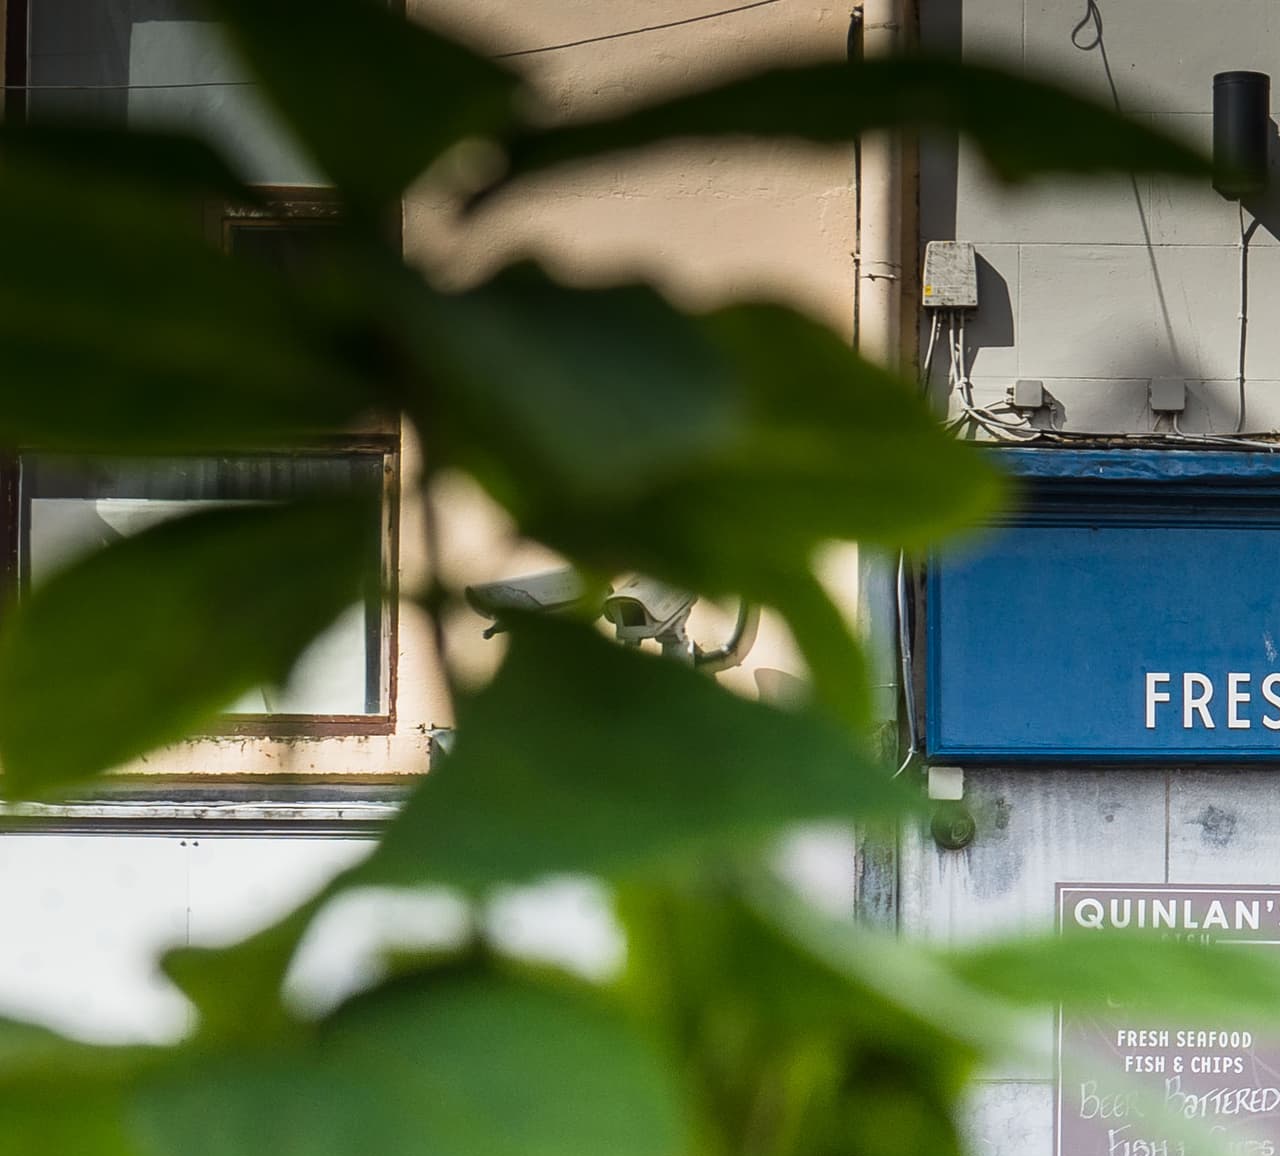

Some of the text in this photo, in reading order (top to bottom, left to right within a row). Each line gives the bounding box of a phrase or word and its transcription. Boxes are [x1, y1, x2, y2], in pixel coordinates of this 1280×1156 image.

[1117, 1030, 1252, 1048] FRESH SEAFOOD
[1125, 1056, 1243, 1073] FISH & CHIPS
